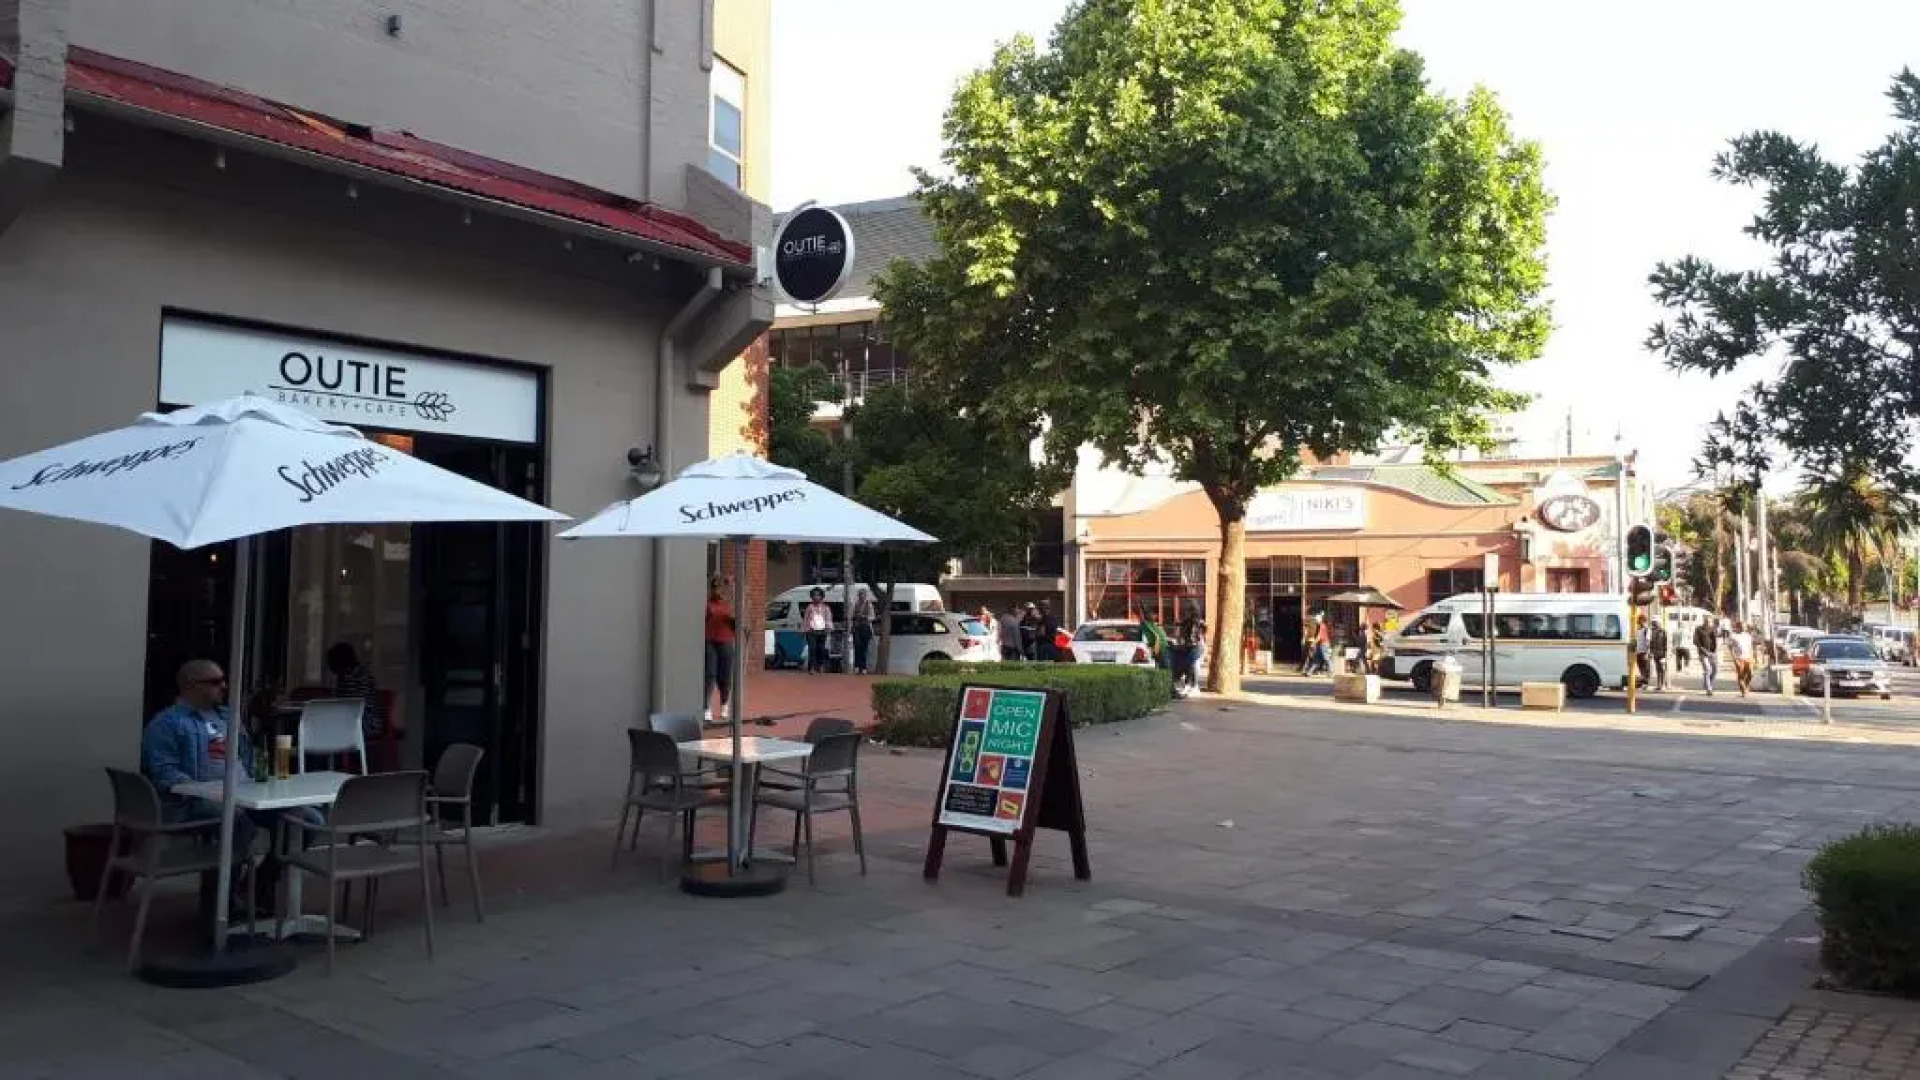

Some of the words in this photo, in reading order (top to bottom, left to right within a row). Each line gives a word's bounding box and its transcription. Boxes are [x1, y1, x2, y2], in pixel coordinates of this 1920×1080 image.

[783, 235, 826, 254] OUTIE
[280, 352, 406, 398] OUTIE
[10, 436, 204, 490] Schweppes
[277, 446, 393, 503] Schweppes
[679, 488, 807, 524] Schweppes
[994, 704, 1036, 718] OPEN
[991, 719, 1032, 738] MIC
[987, 738, 1032, 751] NIGHT
